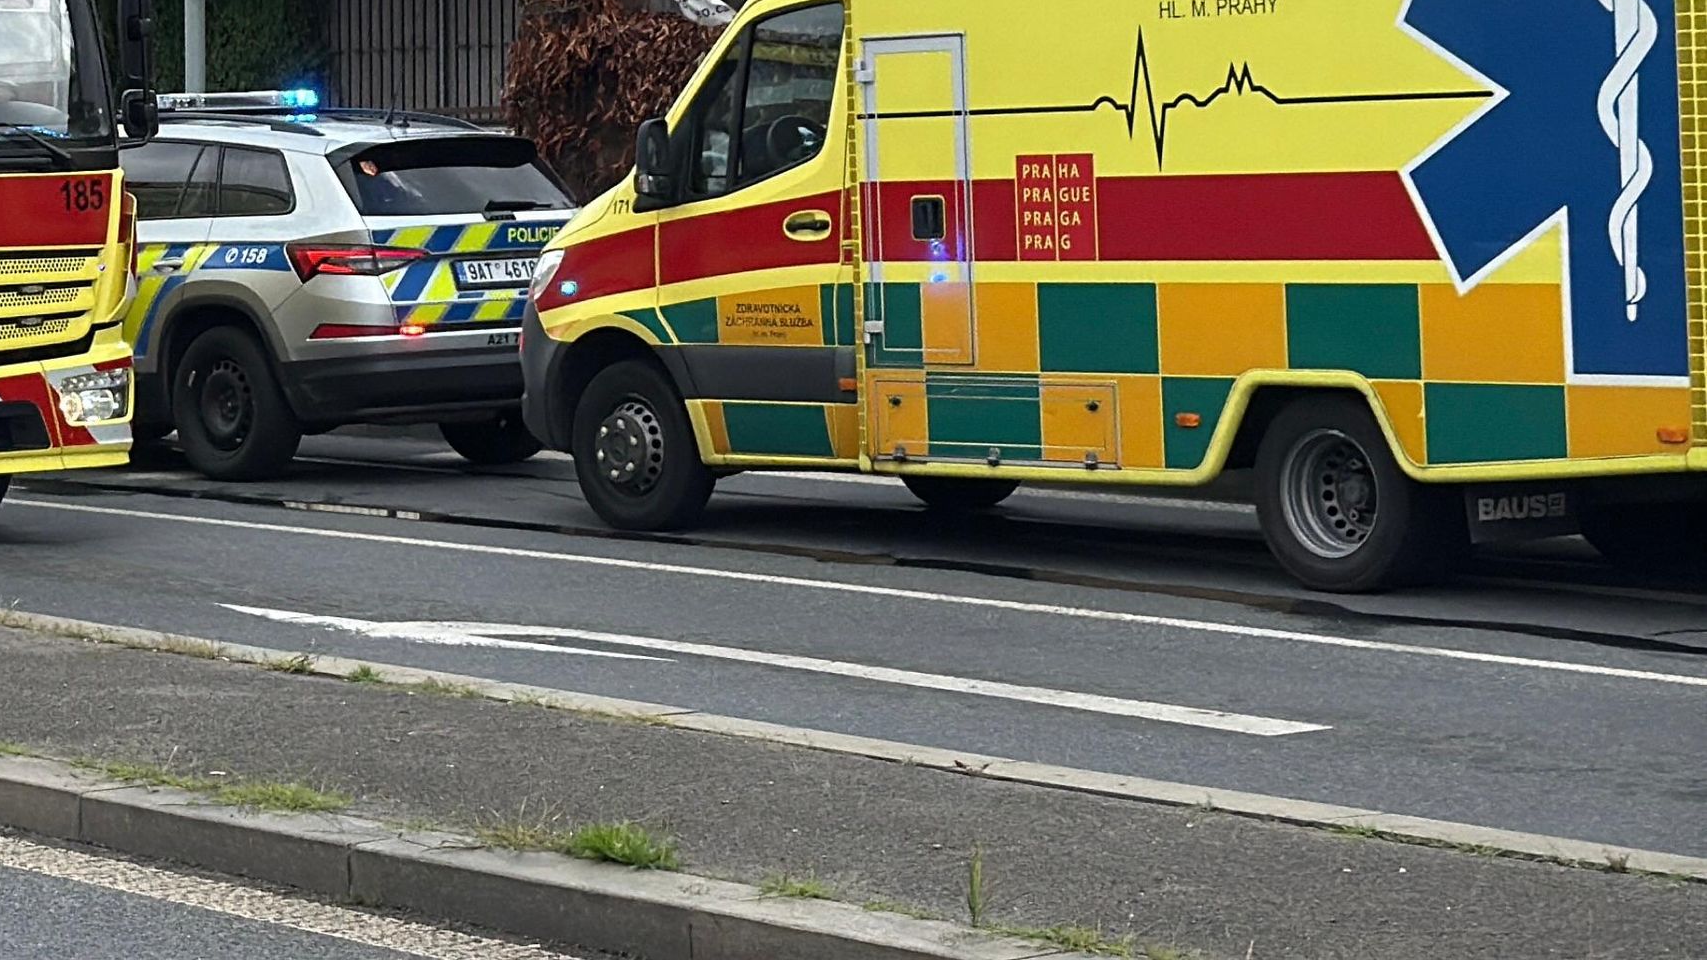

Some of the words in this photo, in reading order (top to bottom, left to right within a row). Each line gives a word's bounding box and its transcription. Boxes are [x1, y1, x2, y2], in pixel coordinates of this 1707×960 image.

[1159, 0, 1186, 19] HL.
[60, 179, 104, 213] 185
[613, 200, 630, 214] 171
[239, 248, 268, 264] 158
[467, 262, 494, 280] 9AT
